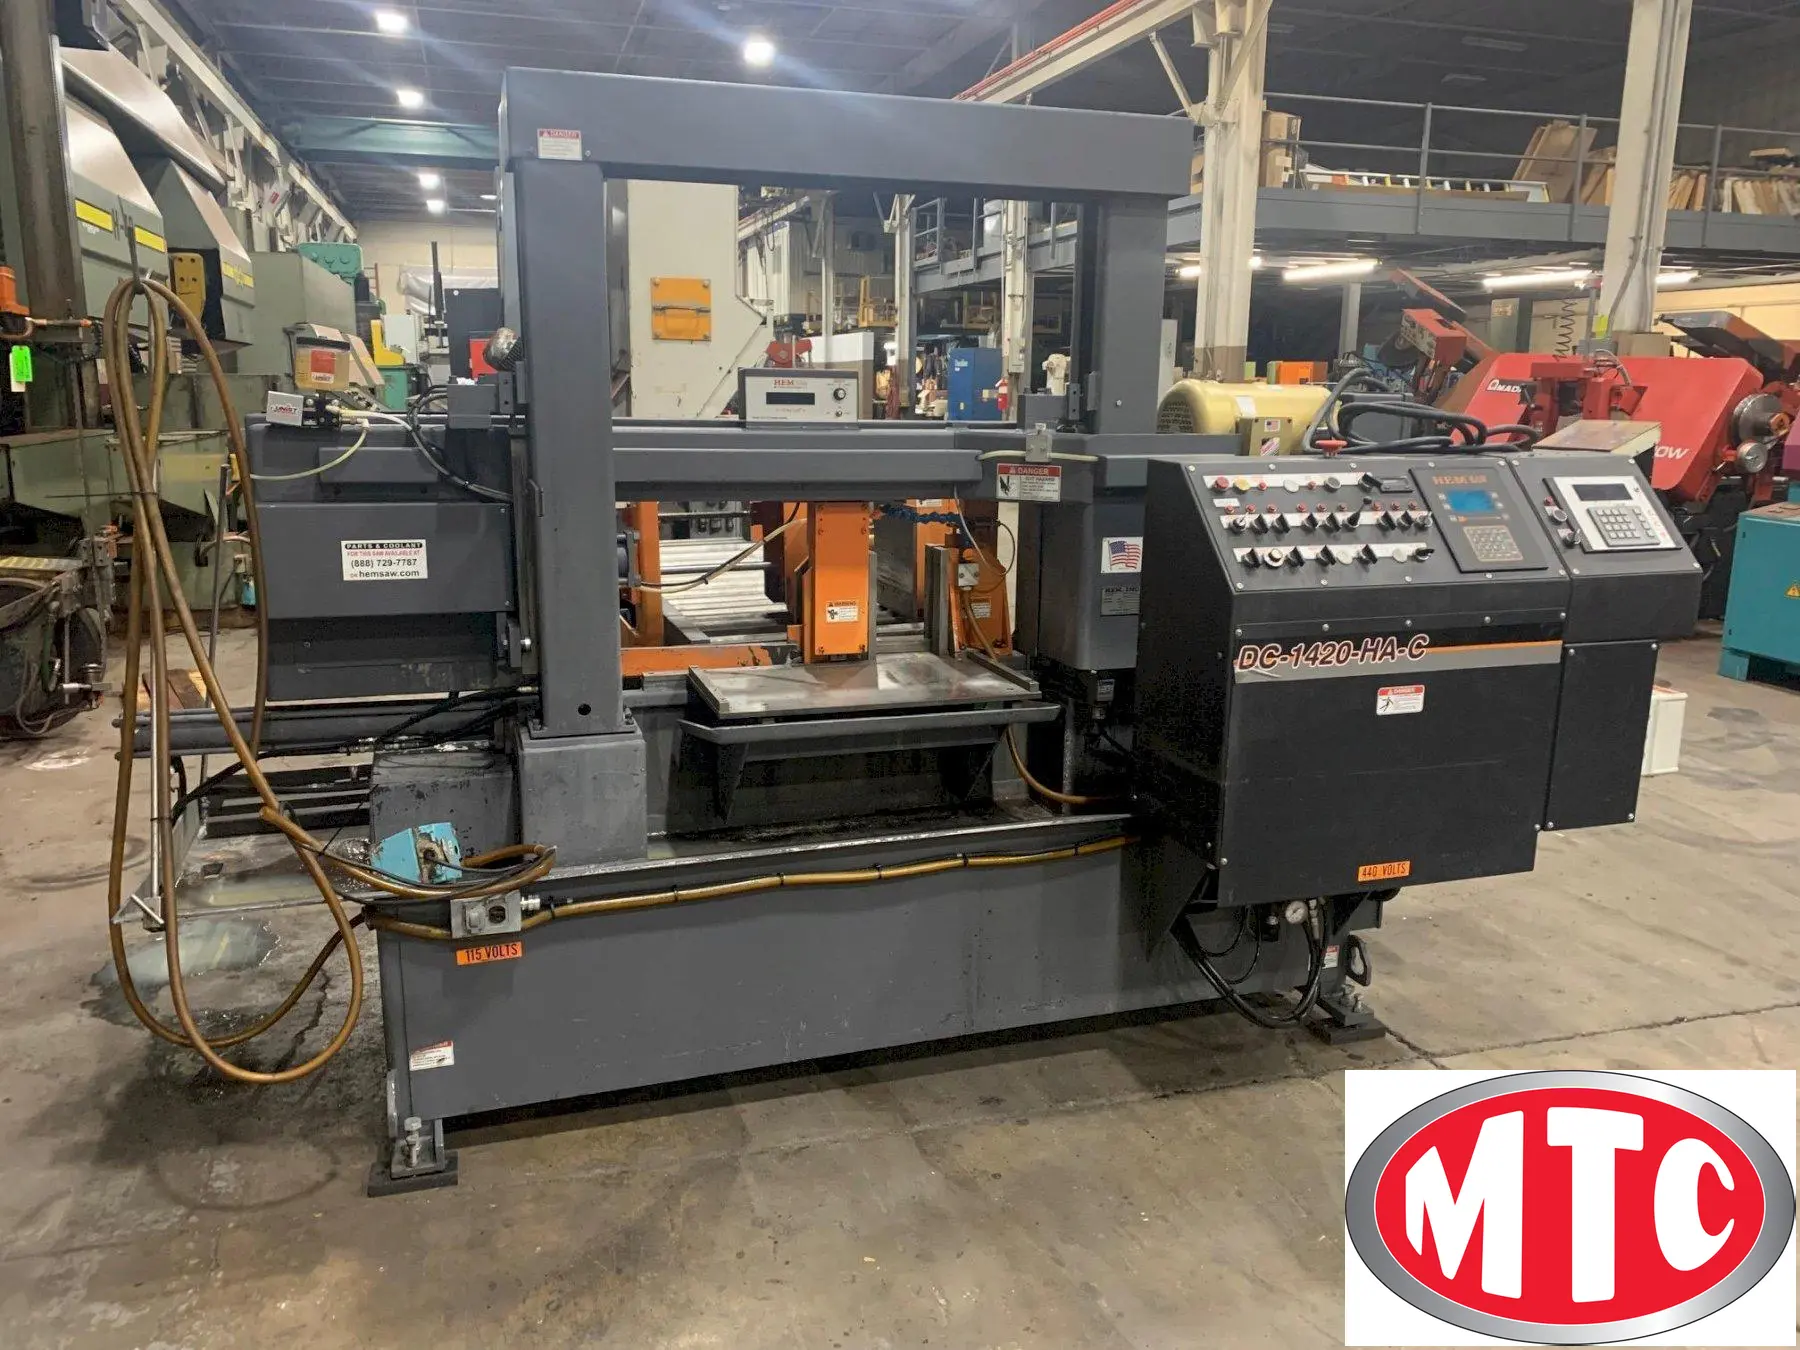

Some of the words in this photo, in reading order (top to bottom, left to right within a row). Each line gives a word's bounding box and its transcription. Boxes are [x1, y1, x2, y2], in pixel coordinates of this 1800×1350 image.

[1486, 380, 1521, 392] AMAD
[1018, 467, 1048, 475] DANGER
[351, 559, 374, 569] (888)
[377, 558, 418, 567] 729-7787
[359, 570, 420, 578] hemsaw.com
[1238, 633, 1430, 671] DC-1420-HA-C
[1362, 866, 1378, 877] 440
[1383, 863, 1406, 876] VOLTS
[466, 949, 482, 962] 115
[486, 943, 518, 958] VOLTS
